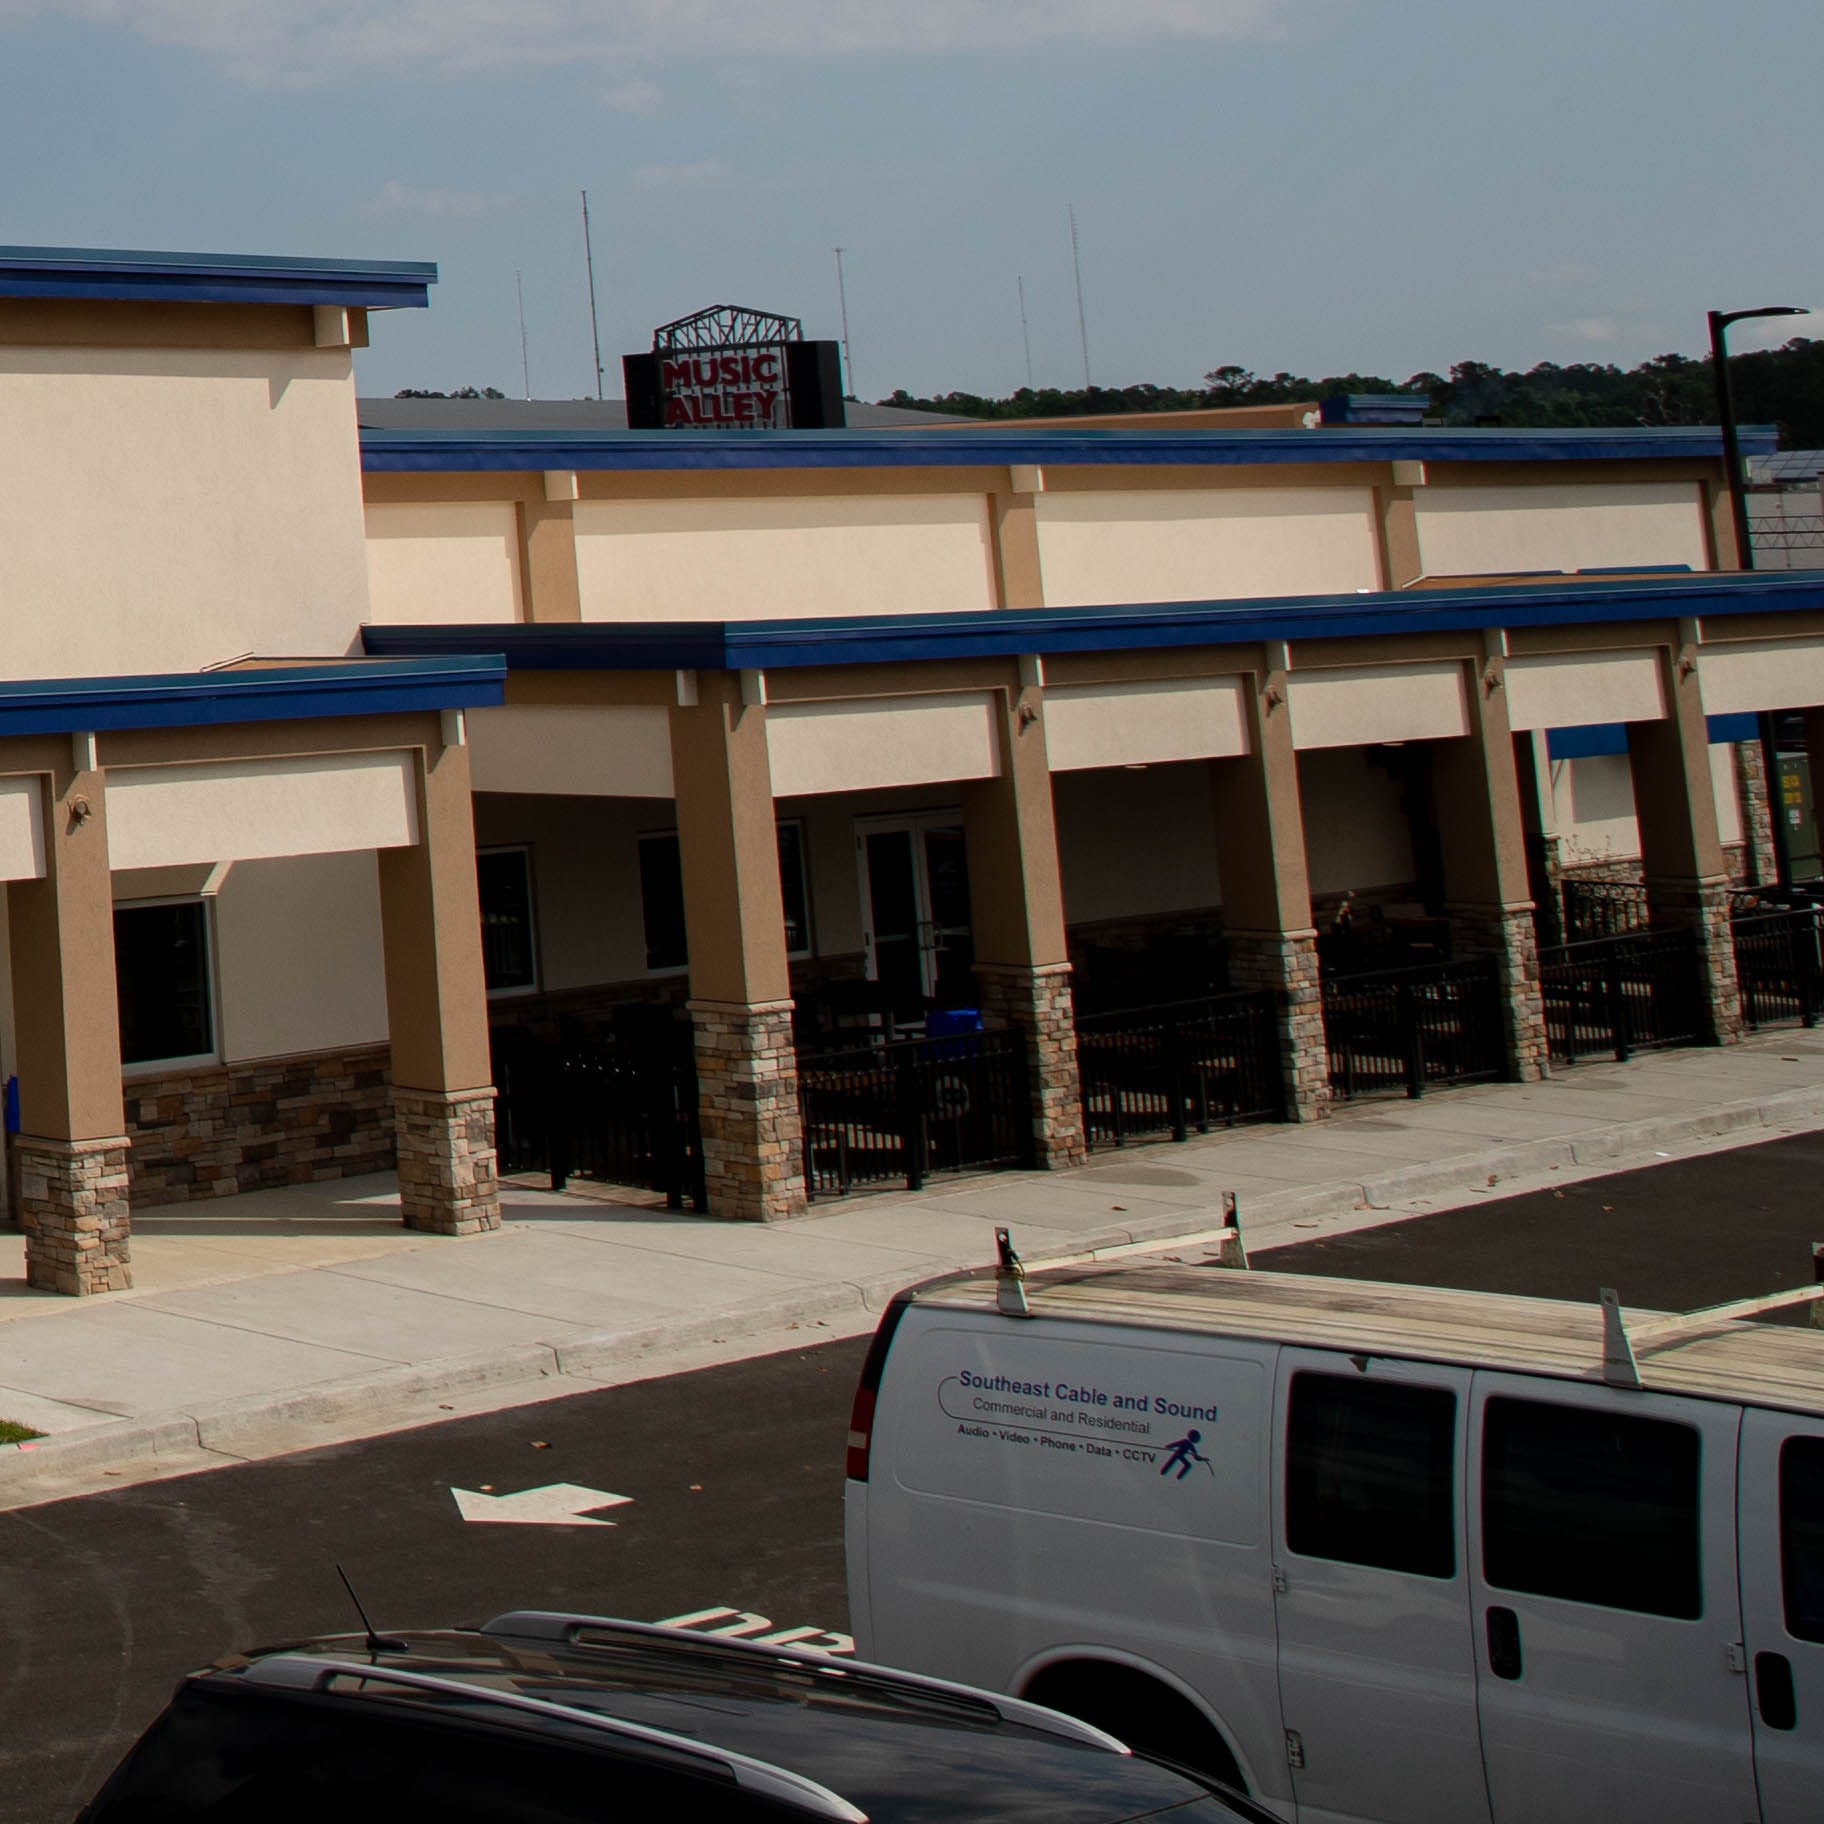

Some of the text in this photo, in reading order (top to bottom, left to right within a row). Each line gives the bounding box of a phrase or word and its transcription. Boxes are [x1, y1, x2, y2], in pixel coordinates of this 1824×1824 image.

[663, 353, 778, 389] MUSIC
[665, 390, 778, 425] ALLEY
[959, 1370, 1218, 1423] Southeast Cable and Sound
[972, 1397, 1151, 1434] Commercial and Residential
[957, 1423, 1156, 1465] Audio Video Phone Data CCTV
